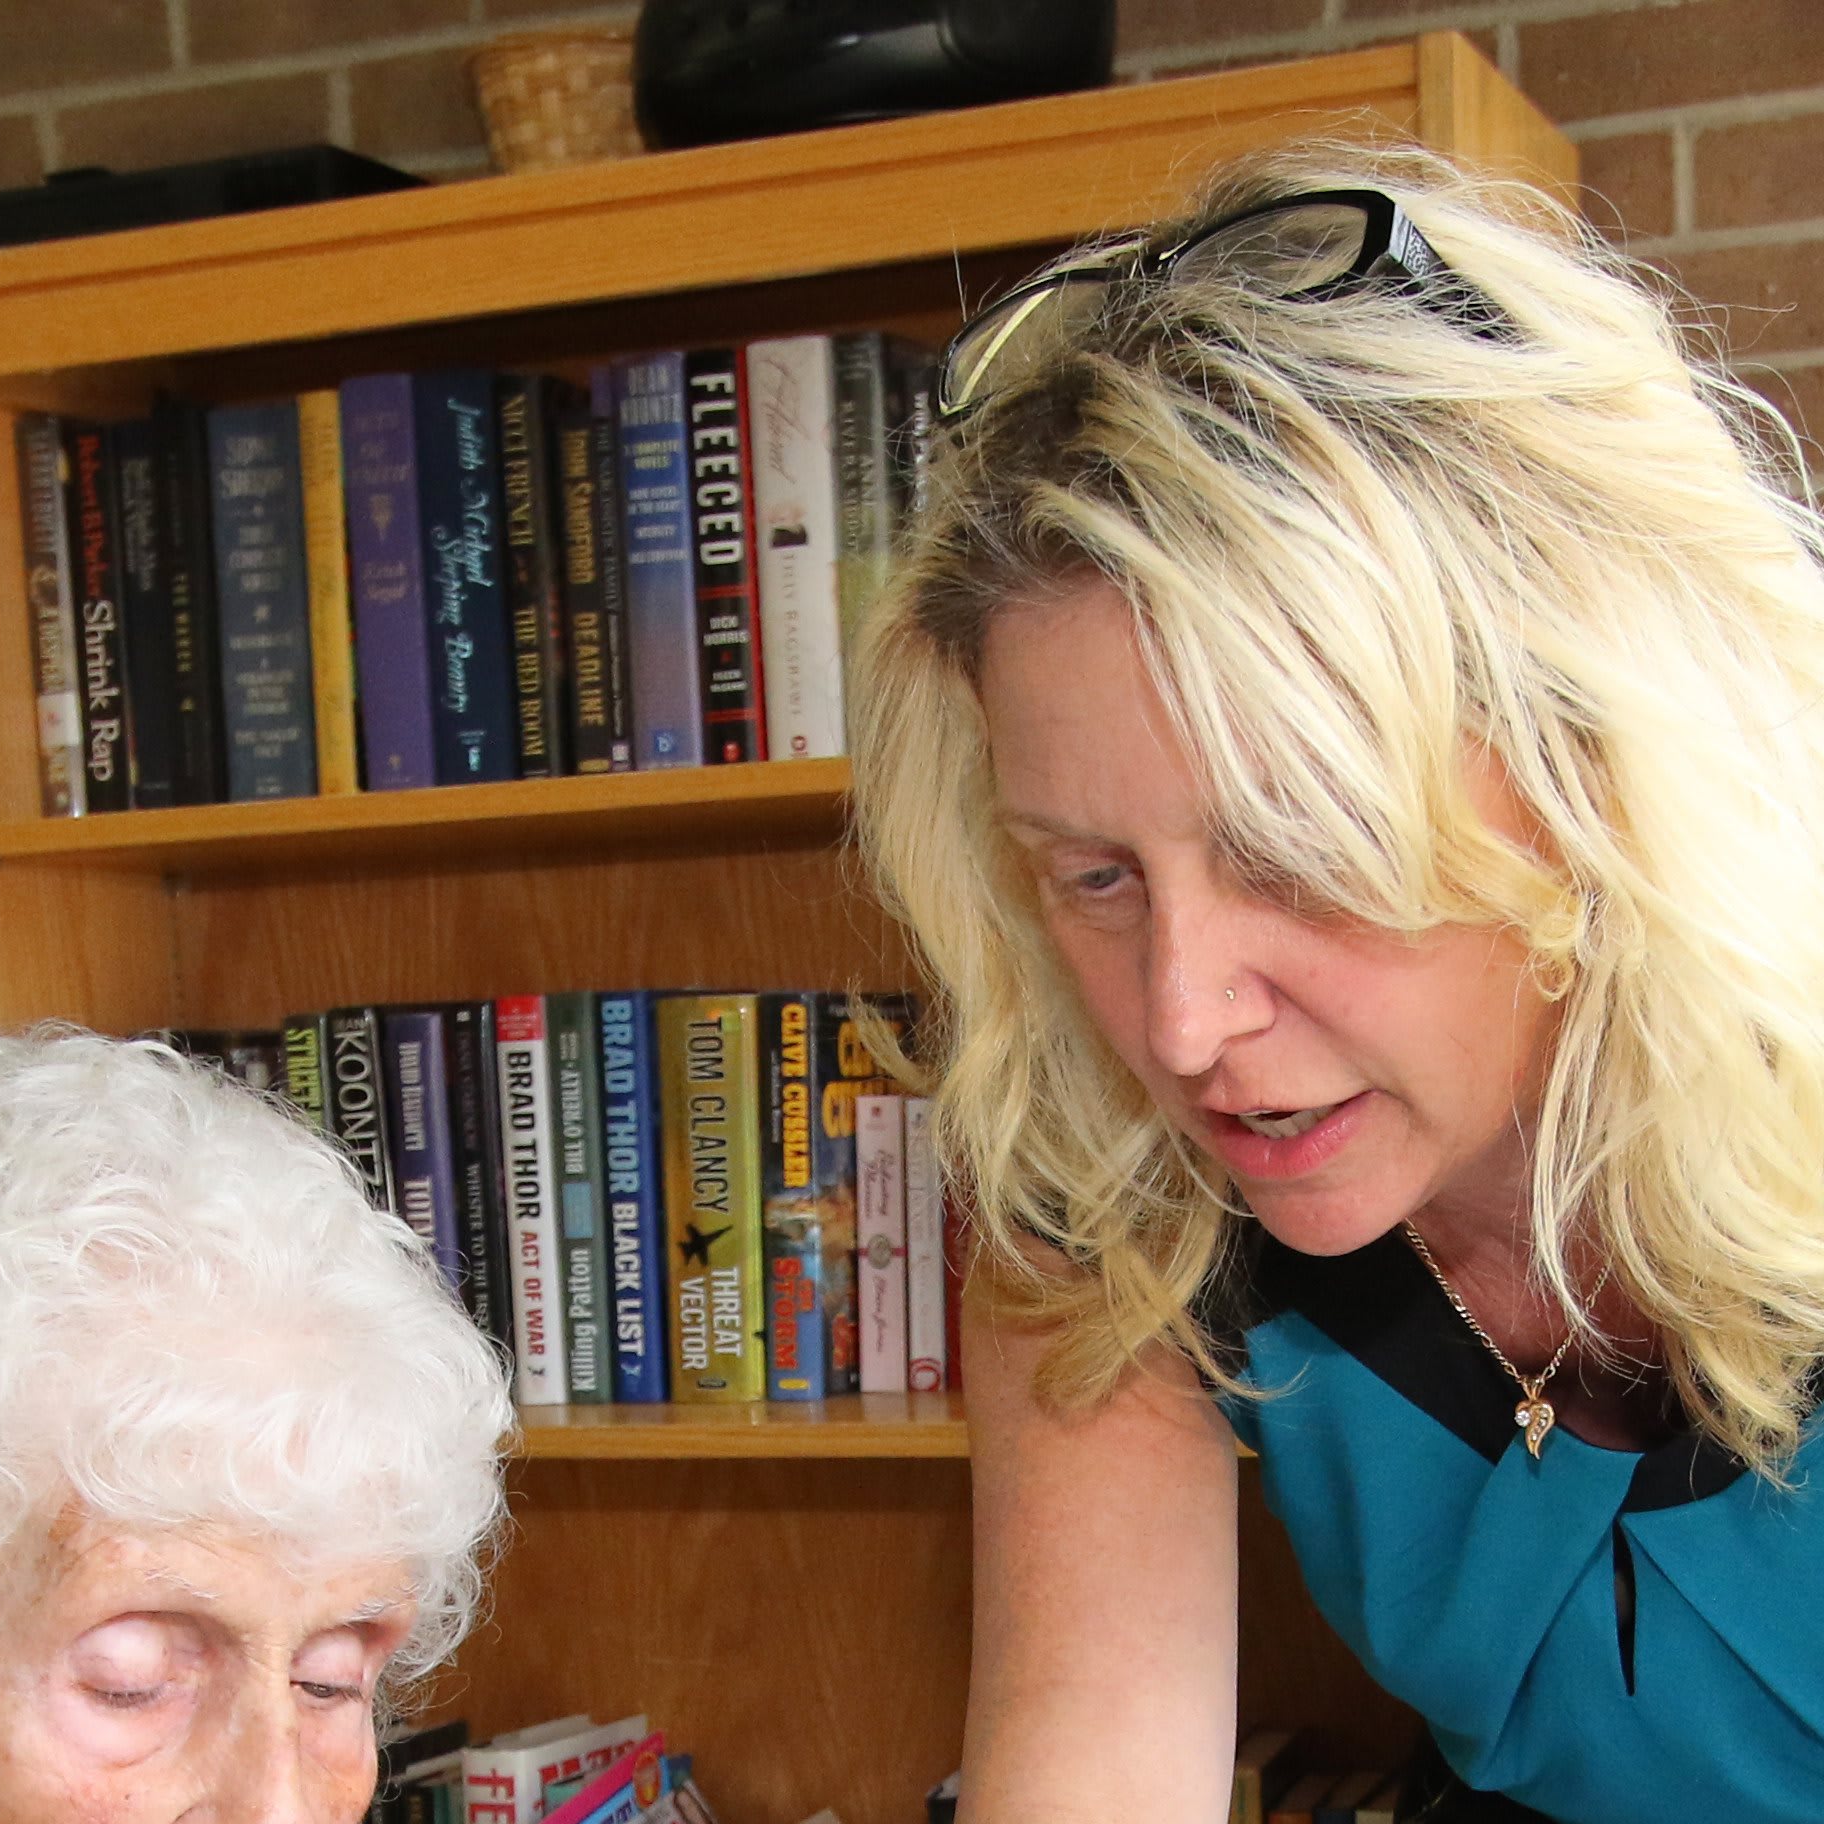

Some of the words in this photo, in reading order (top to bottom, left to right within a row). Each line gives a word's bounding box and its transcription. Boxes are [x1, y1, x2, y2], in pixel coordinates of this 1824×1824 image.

[690, 372, 745, 566] FLEECED
[83, 600, 120, 712] Shrink
[513, 607, 539, 647] THE
[703, 630, 750, 646] MORRIS
[516, 653, 543, 694] RED
[572, 612, 607, 728] DEADLINE
[87, 718, 121, 782] Rap
[519, 699, 546, 757] ROOM
[600, 999, 634, 1094] BRAD
[686, 1017, 724, 1081] TOM
[781, 1003, 809, 1078] CLIVE
[334, 1030, 383, 1188] KOONTZ
[507, 1051, 538, 1130] BRAD
[560, 1069, 584, 1138] O'REILLY
[564, 1140, 586, 1174] BILL
[604, 1100, 640, 1193] THOR
[688, 1095, 730, 1213] CLANCY
[783, 1082, 811, 1189] CUSSLER
[465, 1162, 485, 1231] WHISPER
[512, 1140, 541, 1220] THOR
[471, 1234, 486, 1256] TO
[472, 1260, 488, 1287] THE
[521, 1231, 540, 1268] ACT
[612, 1201, 642, 1290] BLACK
[524, 1278, 541, 1302] OF
[567, 1248, 593, 1318] Patton
[710, 1267, 743, 1356] THREAT
[773, 1257, 803, 1371] STORM
[798, 1279, 815, 1313] THE
[526, 1310, 545, 1356] WAR
[570, 1323, 598, 1391] Killing
[616, 1296, 644, 1357] LIST
[678, 1277, 708, 1370] VECTOR
